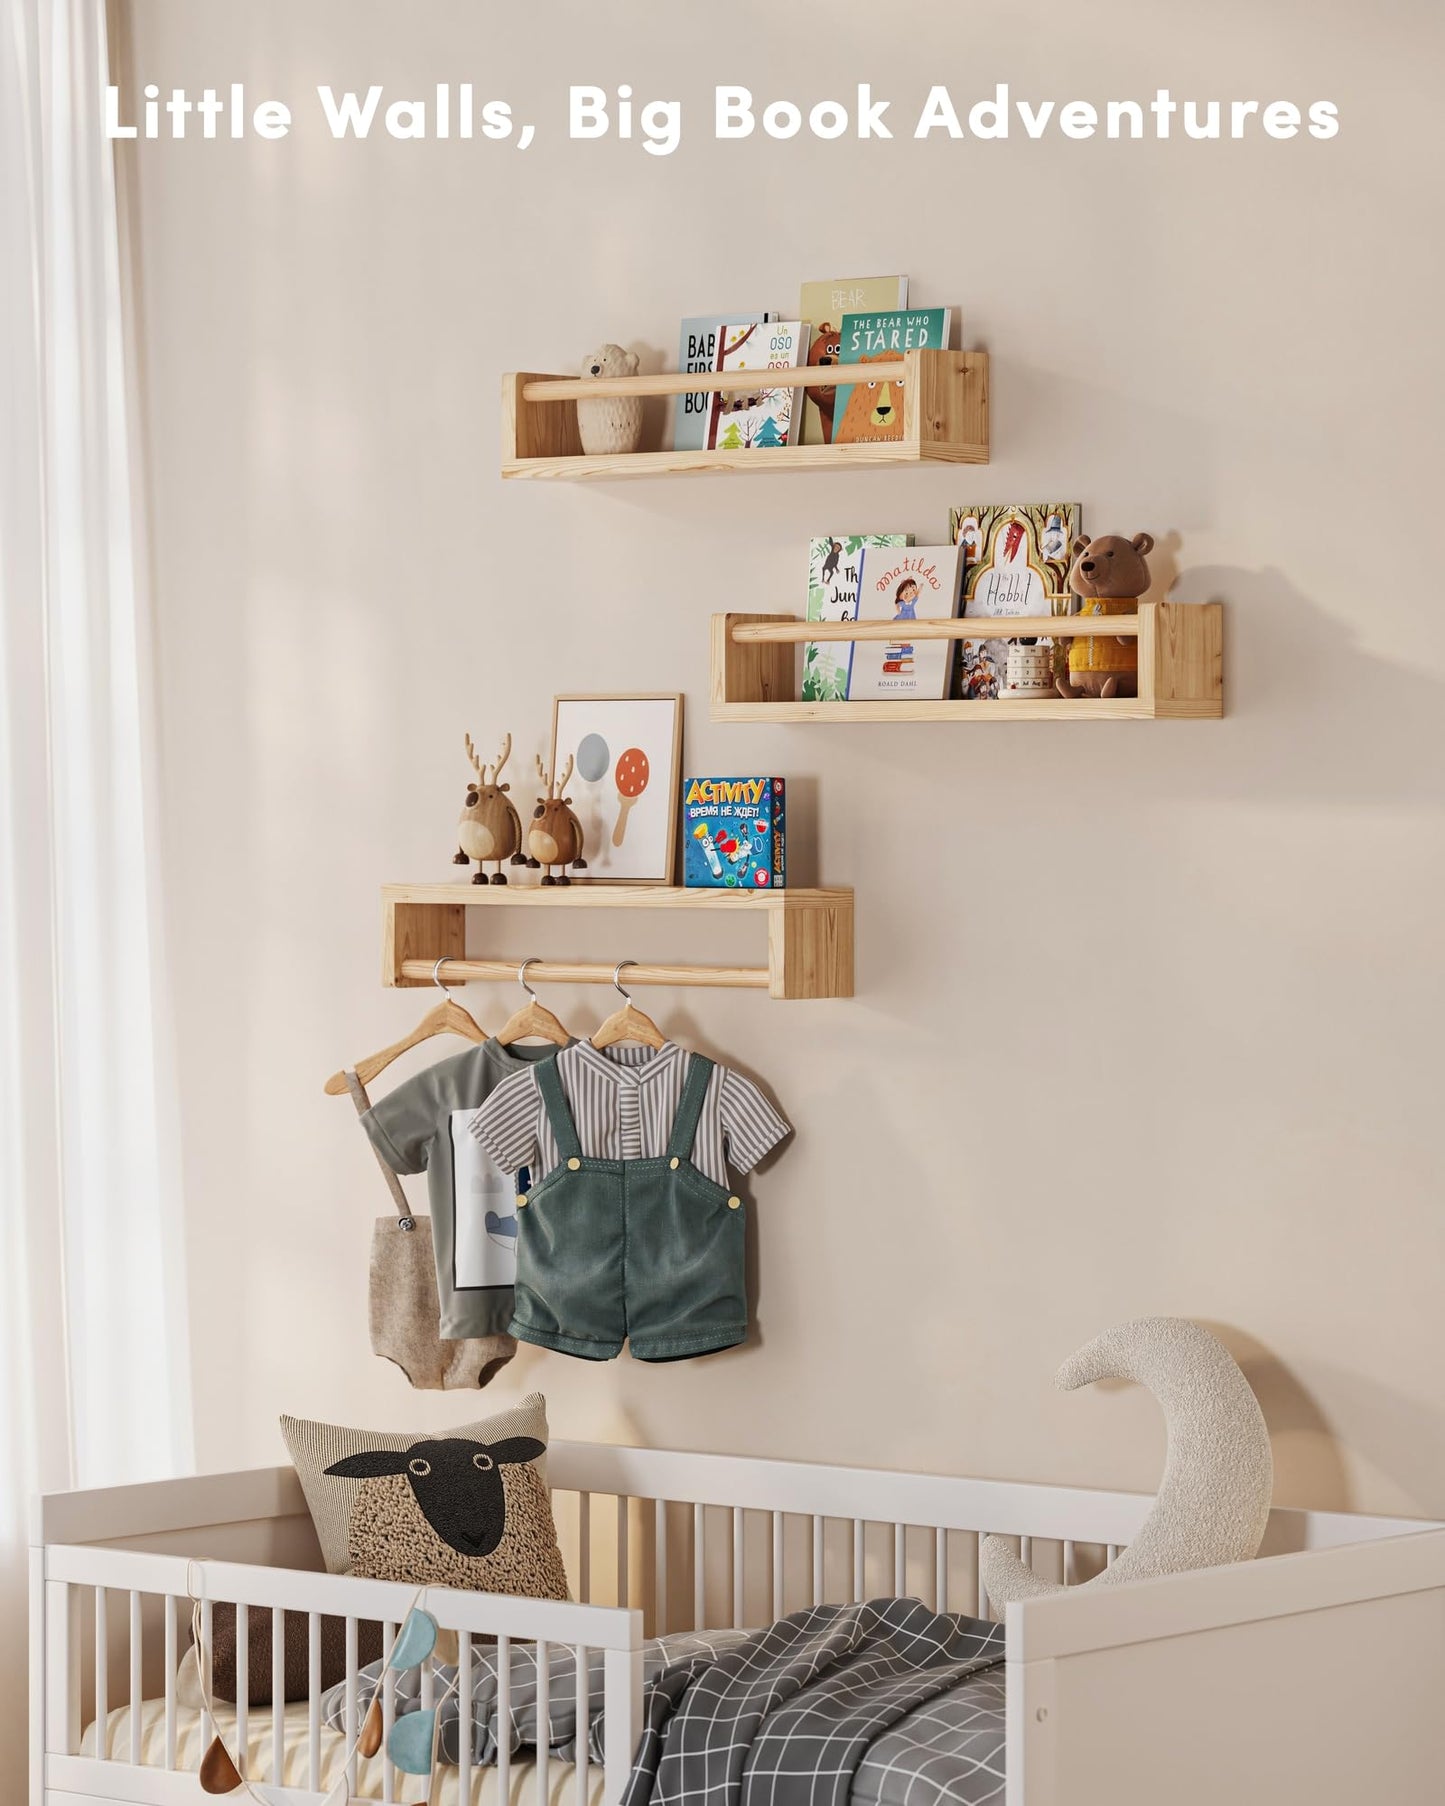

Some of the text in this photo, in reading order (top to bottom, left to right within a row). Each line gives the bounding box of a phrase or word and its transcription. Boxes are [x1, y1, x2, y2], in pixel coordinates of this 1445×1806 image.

[832, 289, 866, 310] BEAR
[777, 326, 788, 336] Un
[853, 315, 929, 330] THE BEAR WHO
[770, 336, 792, 351] OSO
[851, 328, 928, 351] STARED
[987, 572, 1031, 606] Hobbit
[686, 779, 765, 804] ACTIVITY
[690, 806, 759, 818] ВРЕМЯ НЕ ЖДЕТ!
